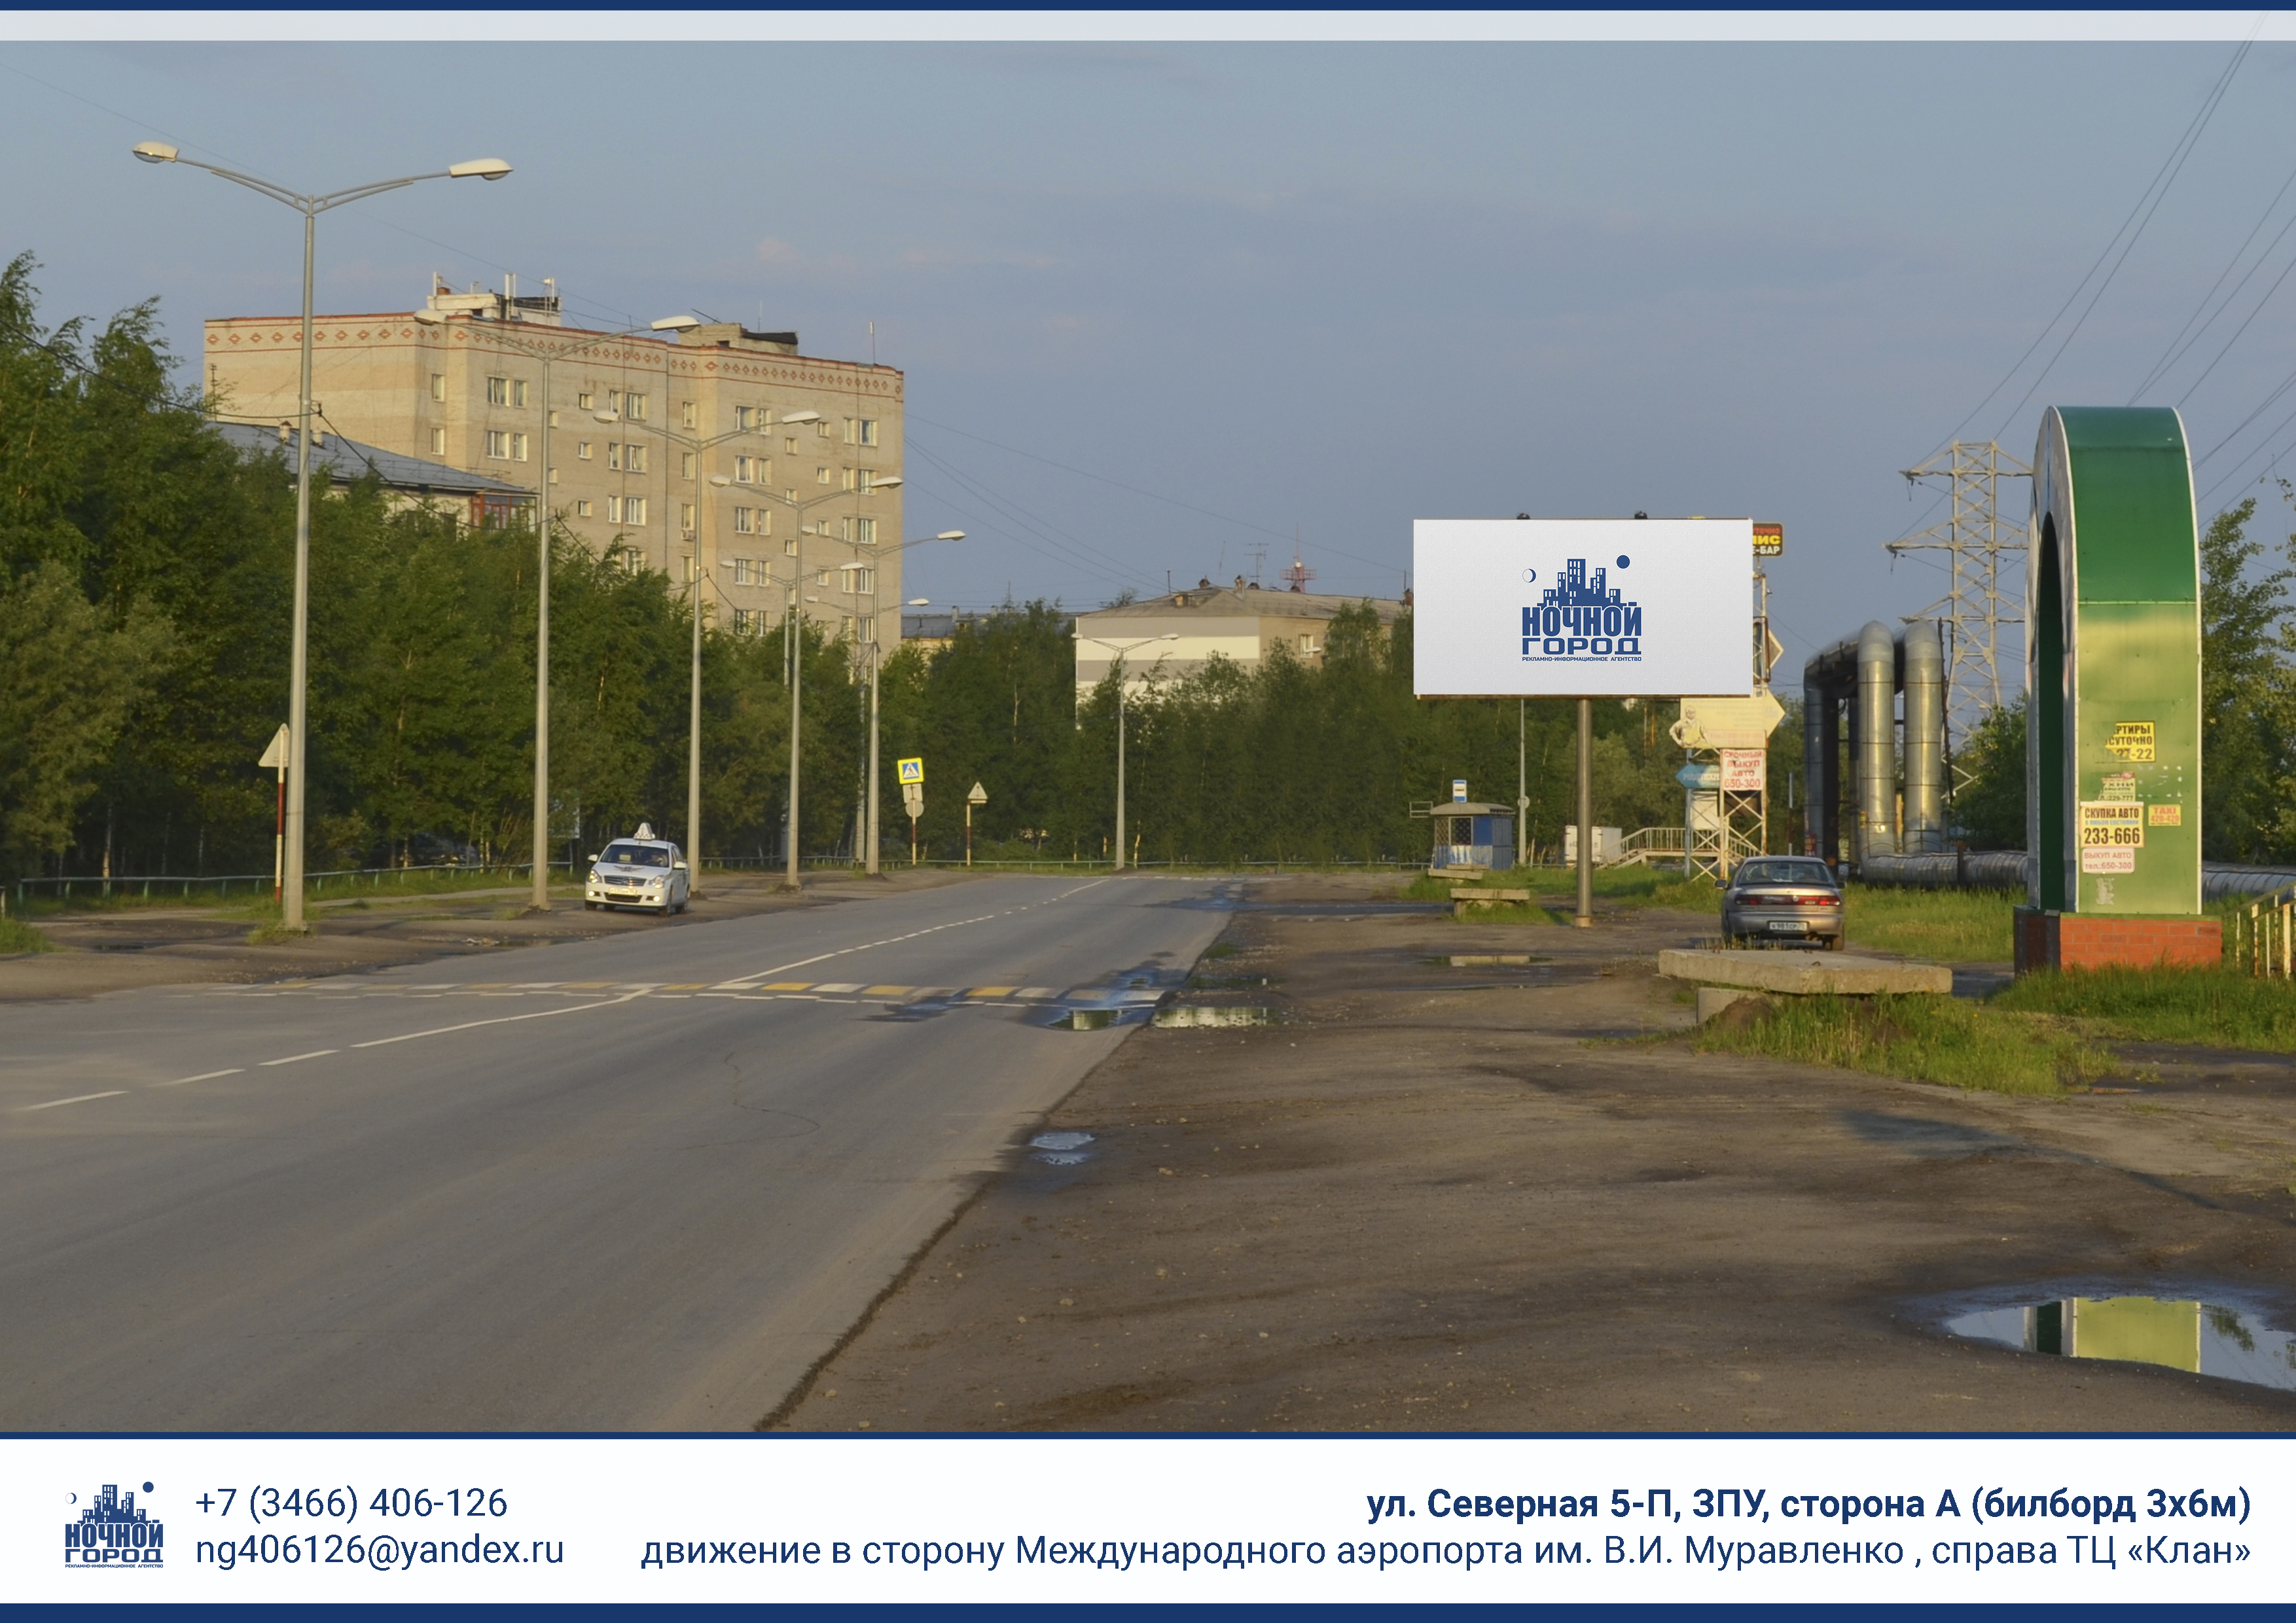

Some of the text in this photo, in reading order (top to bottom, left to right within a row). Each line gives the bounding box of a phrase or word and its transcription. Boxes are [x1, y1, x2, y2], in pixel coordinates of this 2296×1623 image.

[1522, 602, 1641, 636] НОЧНОЙ
[1522, 637, 1641, 655] ГОРОД
[2115, 724, 2150, 734] РТИРЫ
[1724, 778, 1761, 788] 650-300
[2085, 808, 2139, 818] СКУПКА АВТО
[2084, 827, 2140, 844] 233-666
